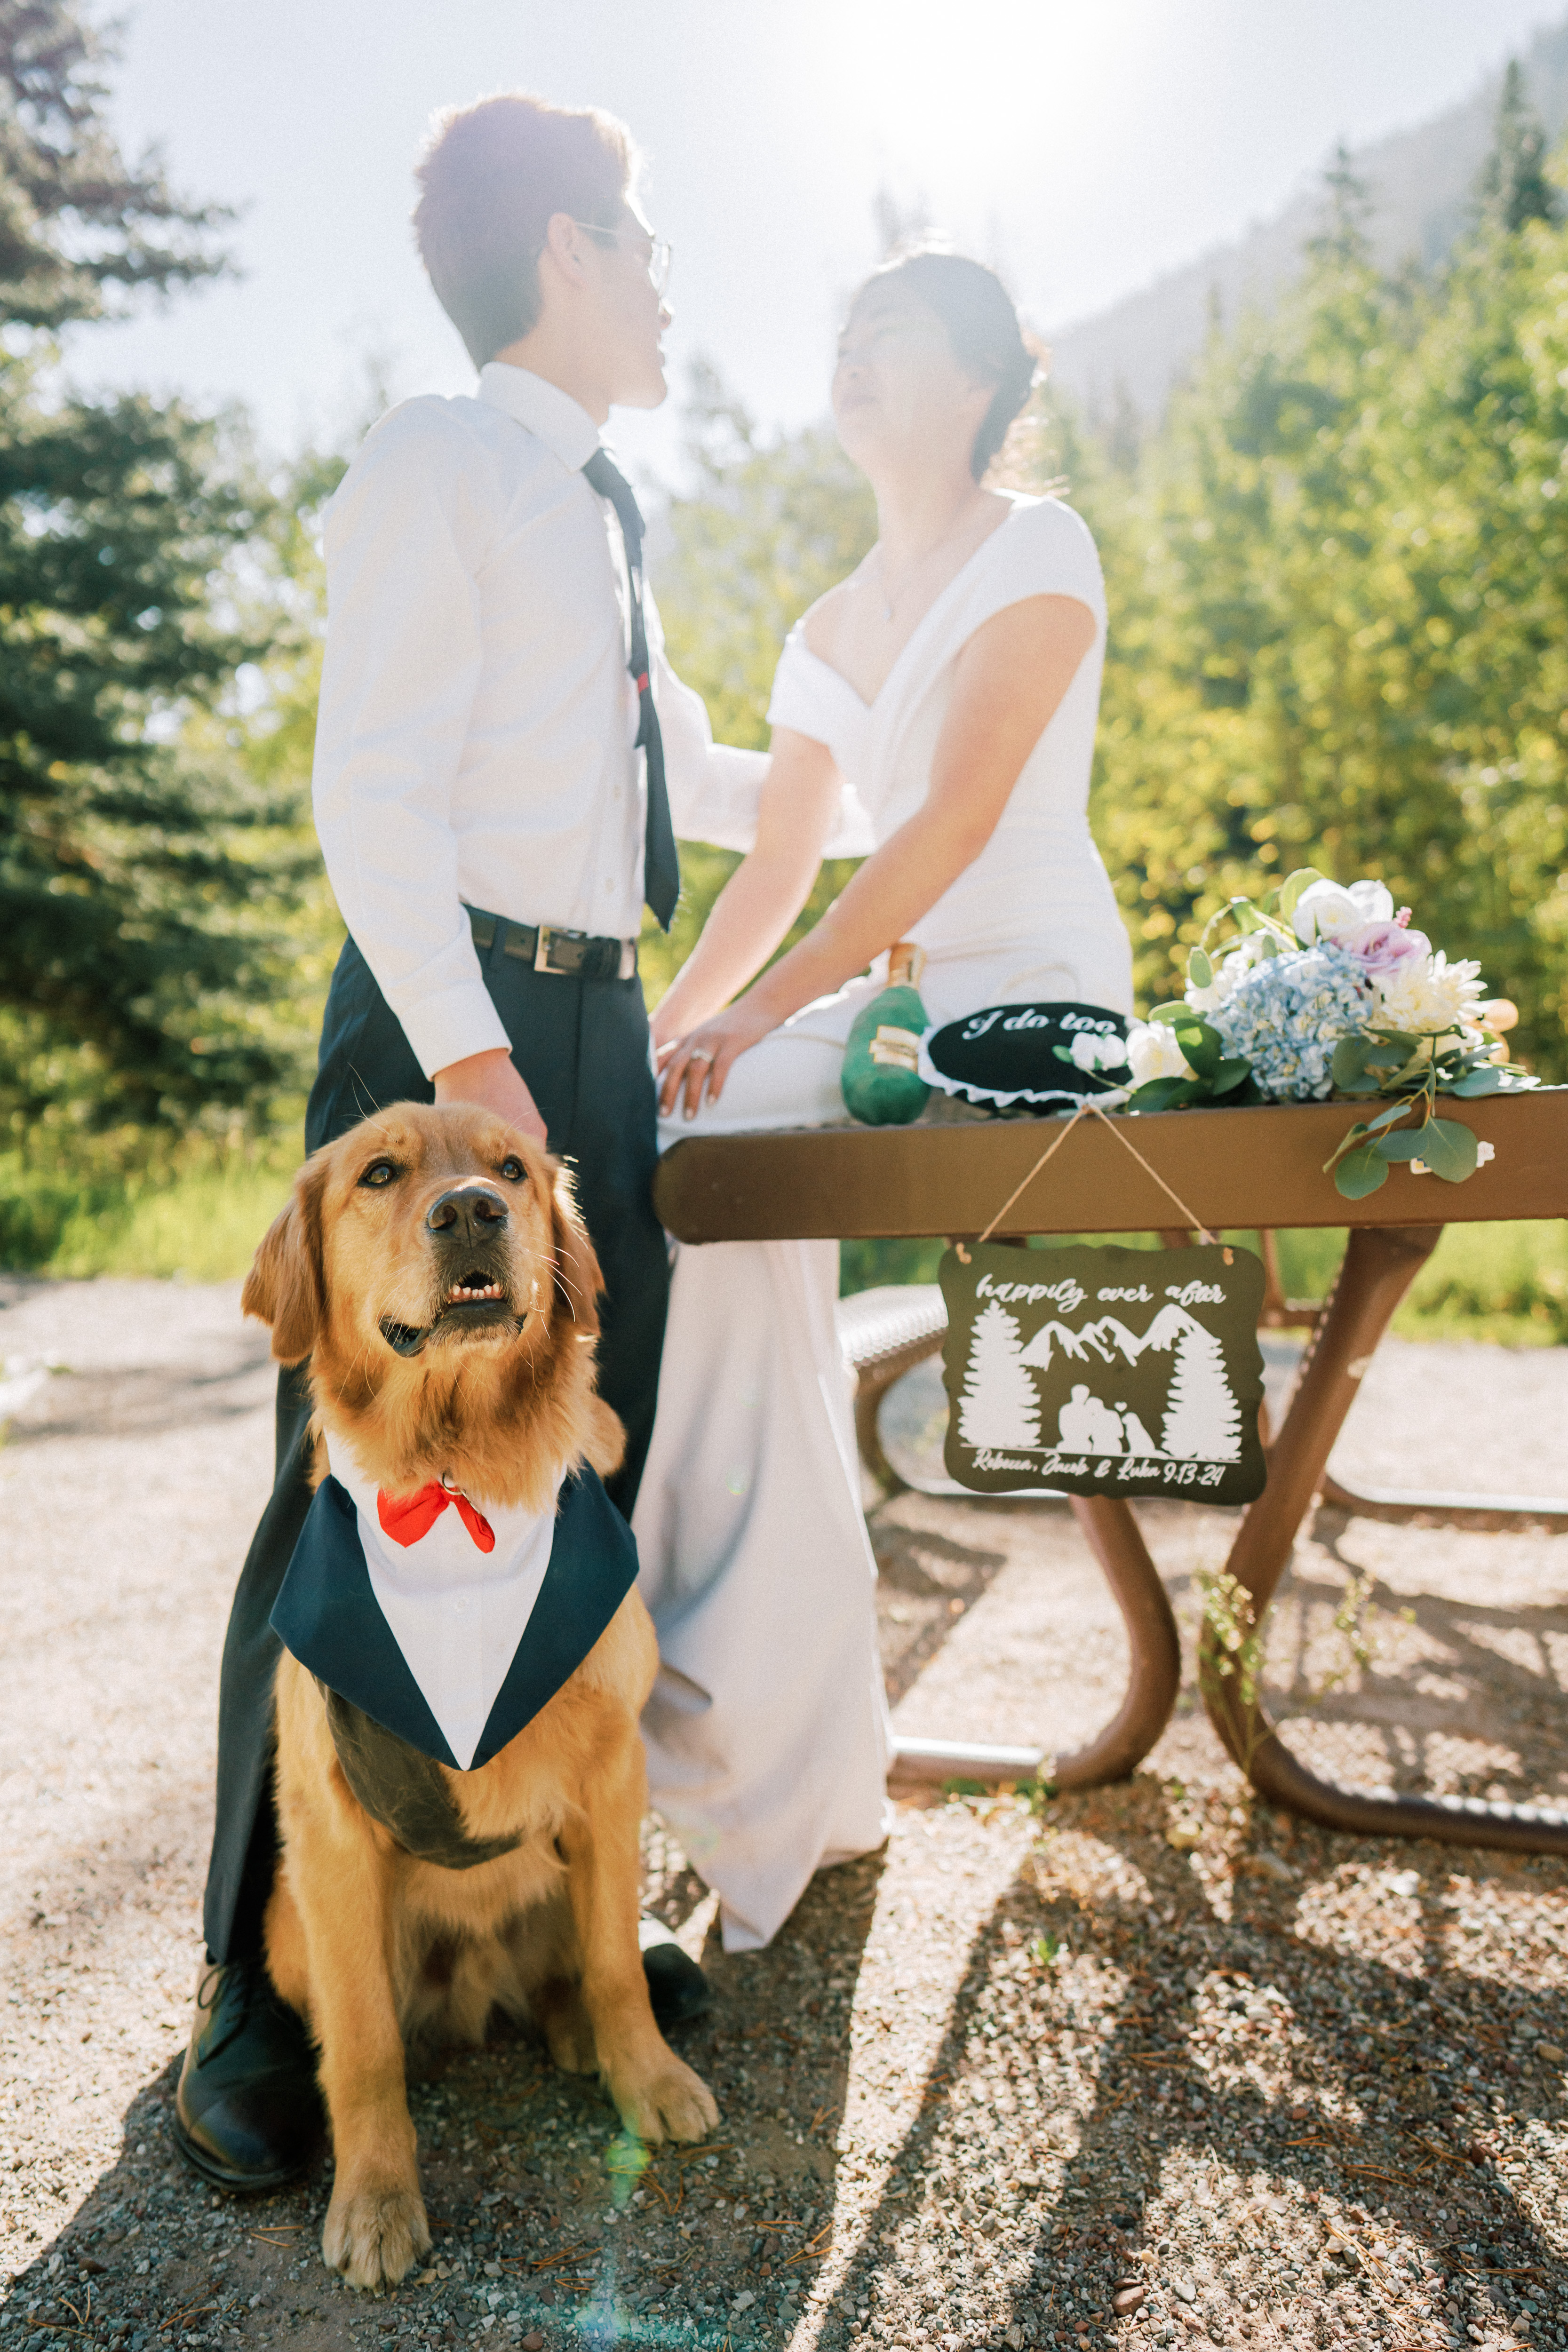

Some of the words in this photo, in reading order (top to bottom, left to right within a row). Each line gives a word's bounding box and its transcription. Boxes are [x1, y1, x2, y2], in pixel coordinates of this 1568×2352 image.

[962, 1010, 1004, 1040] I
[1003, 1008, 1050, 1031] do
[1060, 1012, 1117, 1033] too
[976, 1273, 1089, 1313] happily
[1097, 1284, 1154, 1303] ever
[1164, 1279, 1226, 1307] after
[1041, 1452, 1090, 1476] Jacob
[1093, 1459, 1112, 1478] &
